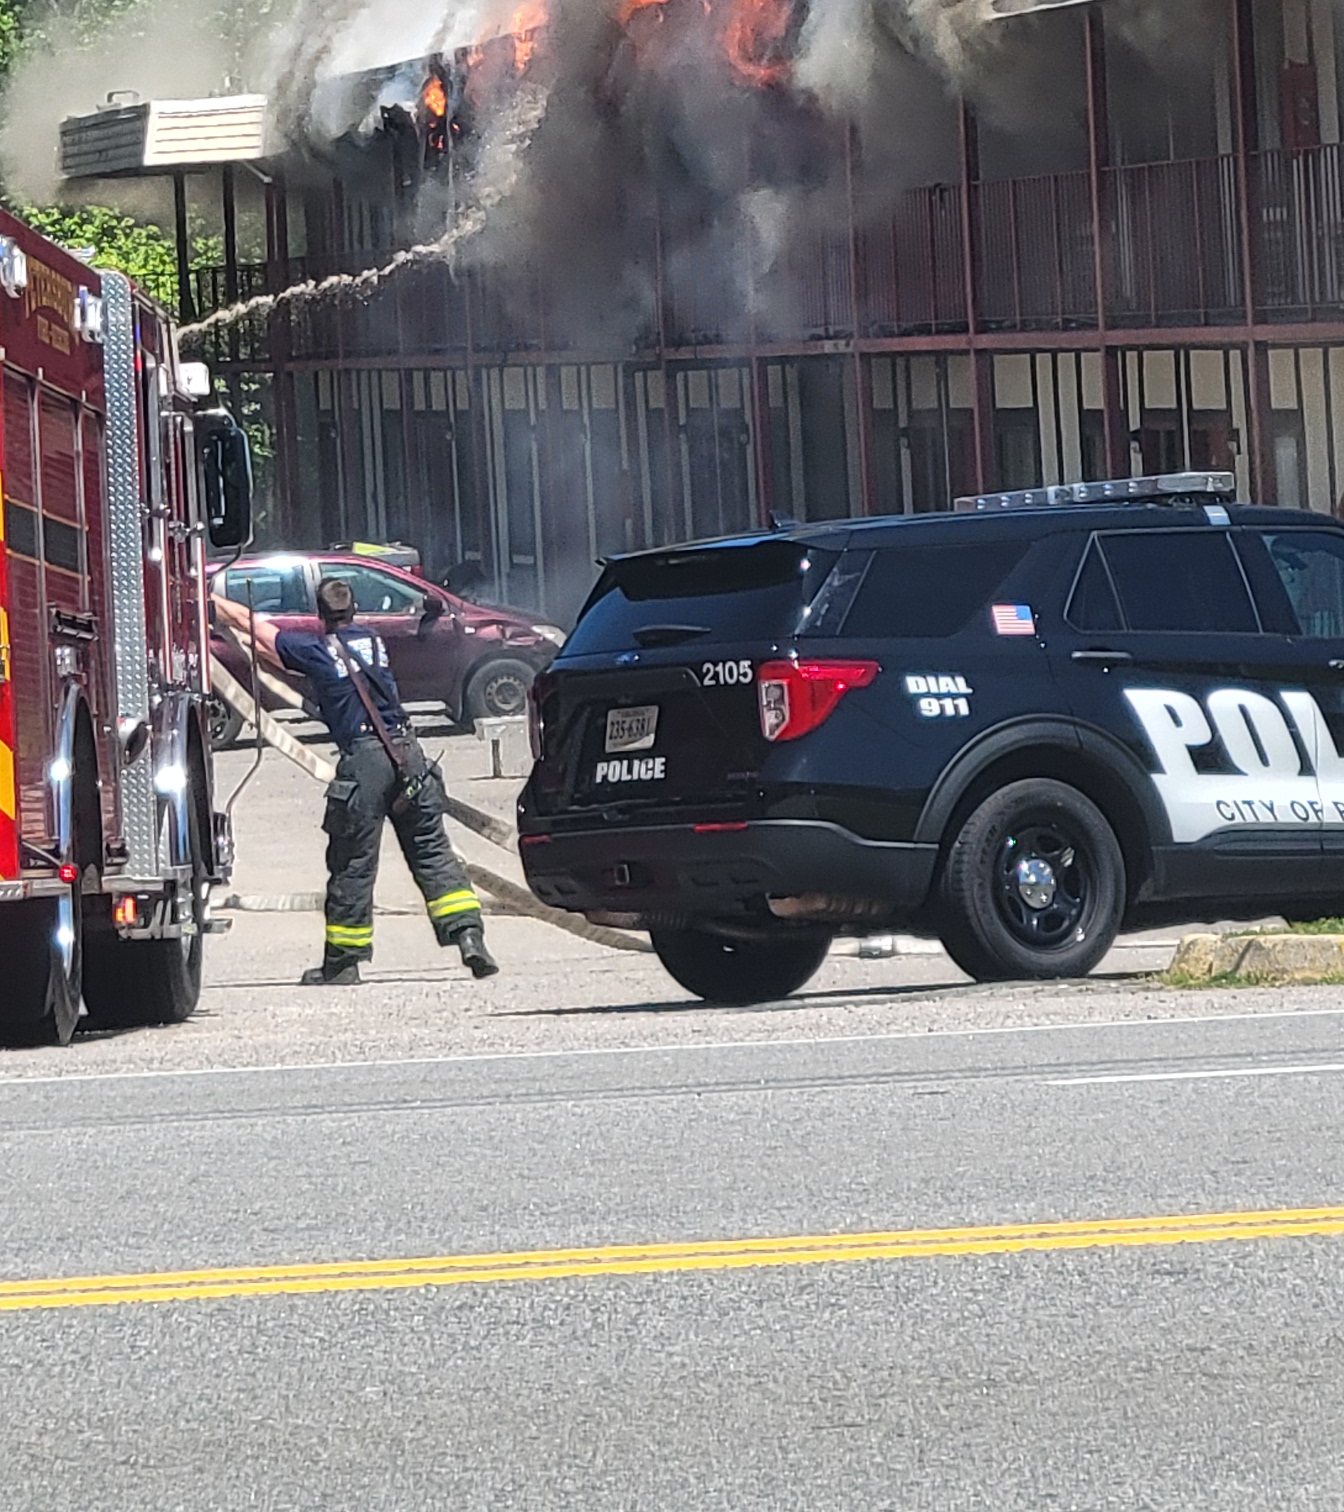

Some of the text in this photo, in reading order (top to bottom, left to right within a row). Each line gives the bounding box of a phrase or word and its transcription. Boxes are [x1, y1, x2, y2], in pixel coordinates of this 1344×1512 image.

[702, 660, 753, 686] 2105
[905, 675, 973, 694] DIAL
[919, 697, 970, 717] 911
[595, 757, 666, 784] POLICE
[1216, 800, 1278, 822] CITY
[1289, 800, 1323, 822] OF
